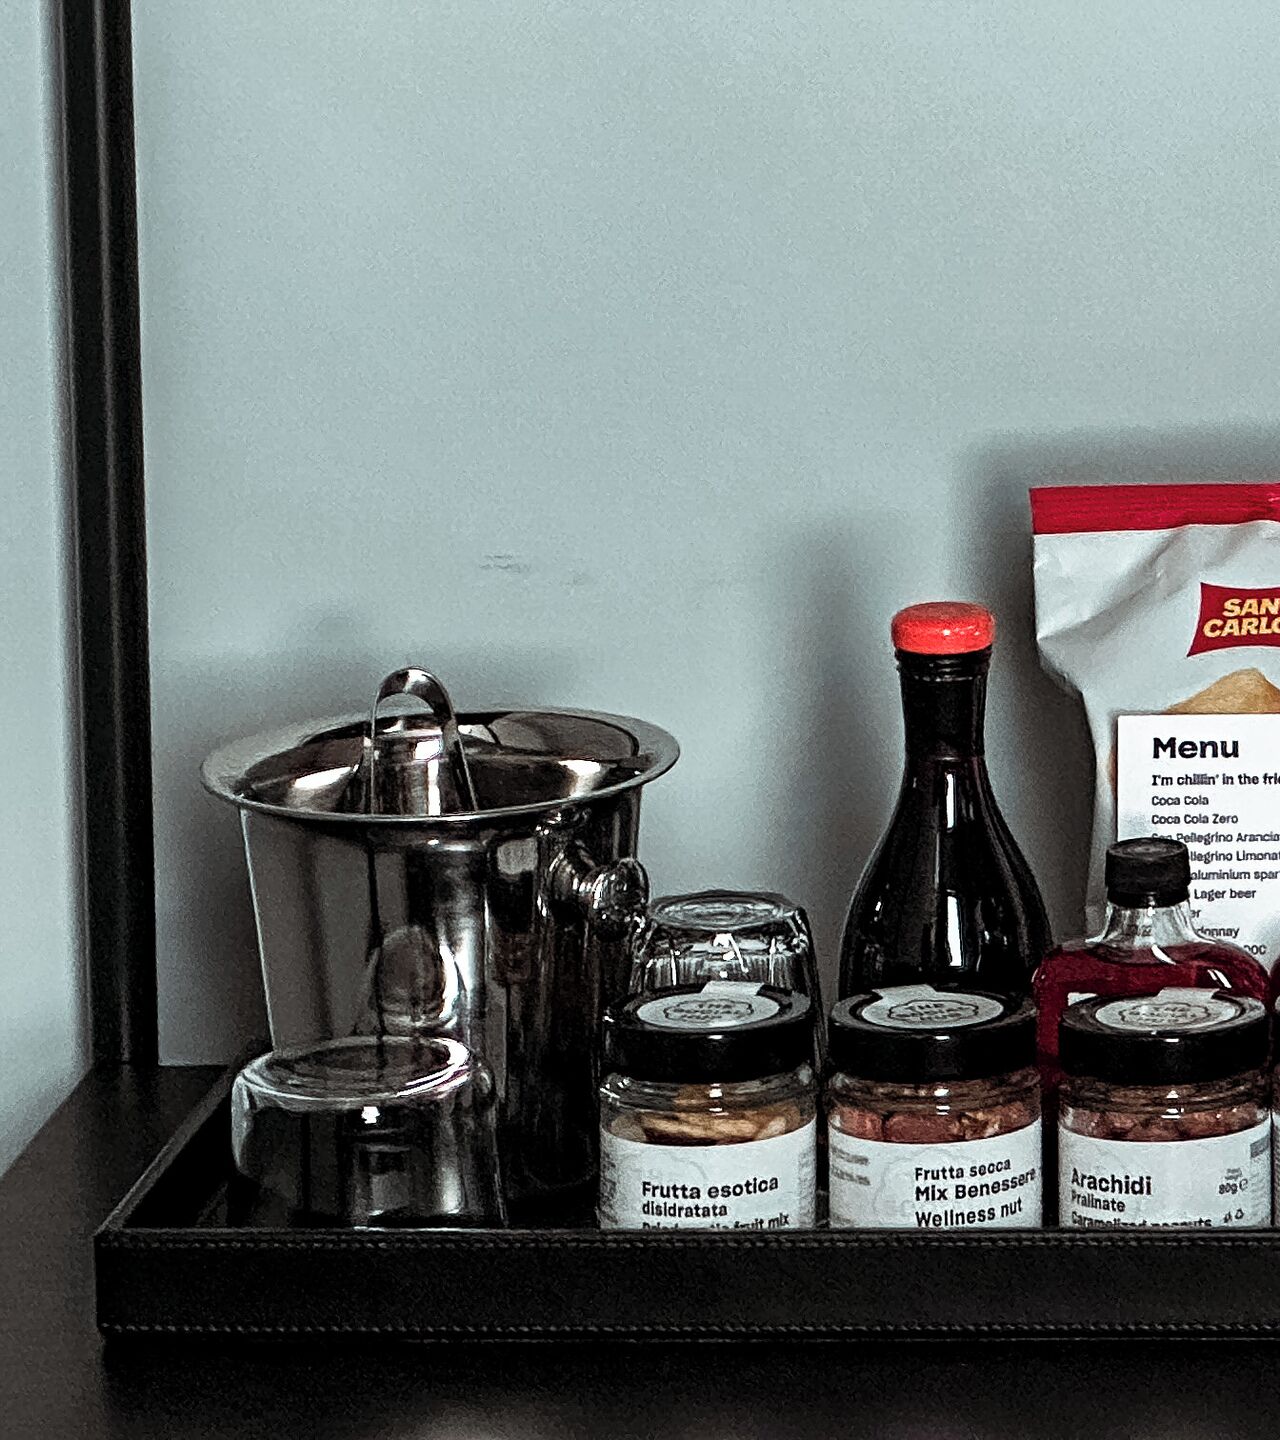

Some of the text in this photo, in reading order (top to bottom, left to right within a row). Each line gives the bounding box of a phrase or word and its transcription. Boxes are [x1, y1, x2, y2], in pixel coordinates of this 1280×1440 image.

[1222, 597, 1280, 618] SAN
[1152, 736, 1240, 759] Menu
[1151, 774, 1173, 786] I'm
[1222, 773, 1234, 786] in
[1238, 773, 1259, 785] the
[1151, 795, 1181, 806] Coca
[1184, 794, 1209, 806] Cola
[1151, 813, 1181, 825] Coca
[1183, 813, 1209, 825] Cola
[1212, 813, 1239, 825] Zero
[1176, 831, 1233, 845] Pellegrino
[1190, 850, 1233, 864] llegrino
[1194, 888, 1257, 902] Lager beer
[915, 1158, 1011, 1181] Frutta secca
[642, 1177, 779, 1200] Frutta esotica
[915, 1168, 1036, 1201] Mix Benessere
[1071, 1167, 1152, 1196] Arachidi
[642, 1200, 728, 1218] disidratata
[1071, 1190, 1126, 1212] Pralinate
[915, 1196, 1023, 1228] Wellness nut
